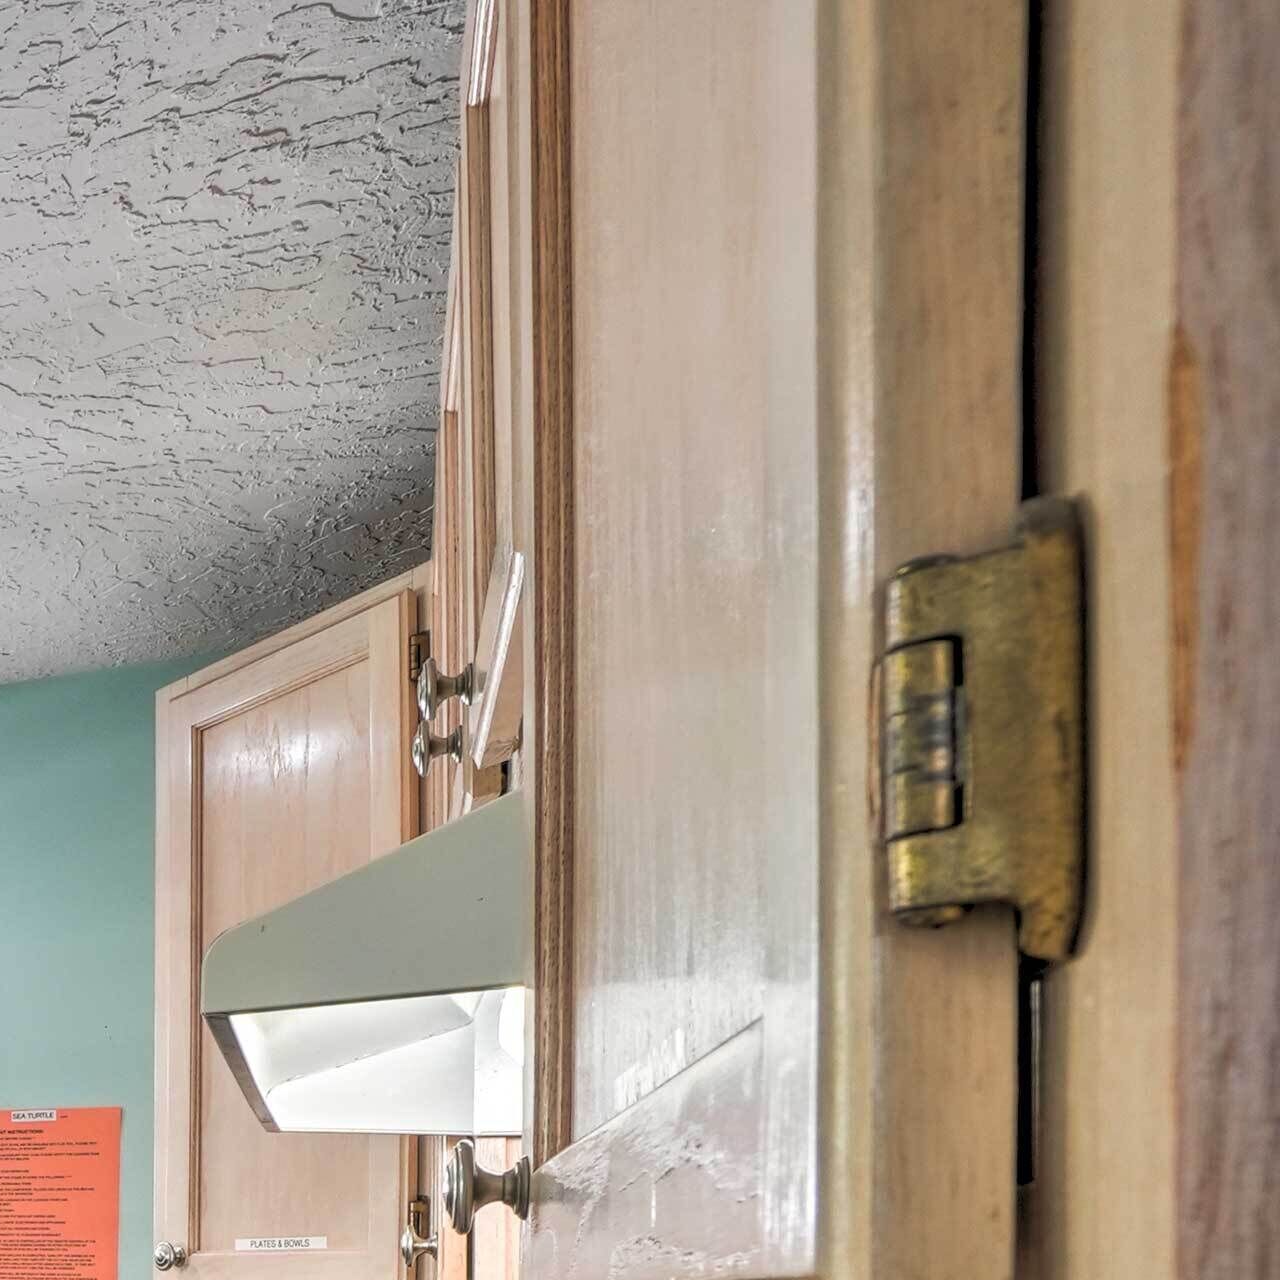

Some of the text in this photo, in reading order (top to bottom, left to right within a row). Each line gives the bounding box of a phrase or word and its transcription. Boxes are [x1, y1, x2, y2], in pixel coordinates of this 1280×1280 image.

[28, 1111, 55, 1119] TURTLE
[250, 1240, 276, 1248] PLATES
[284, 1238, 310, 1248] BOWLS
